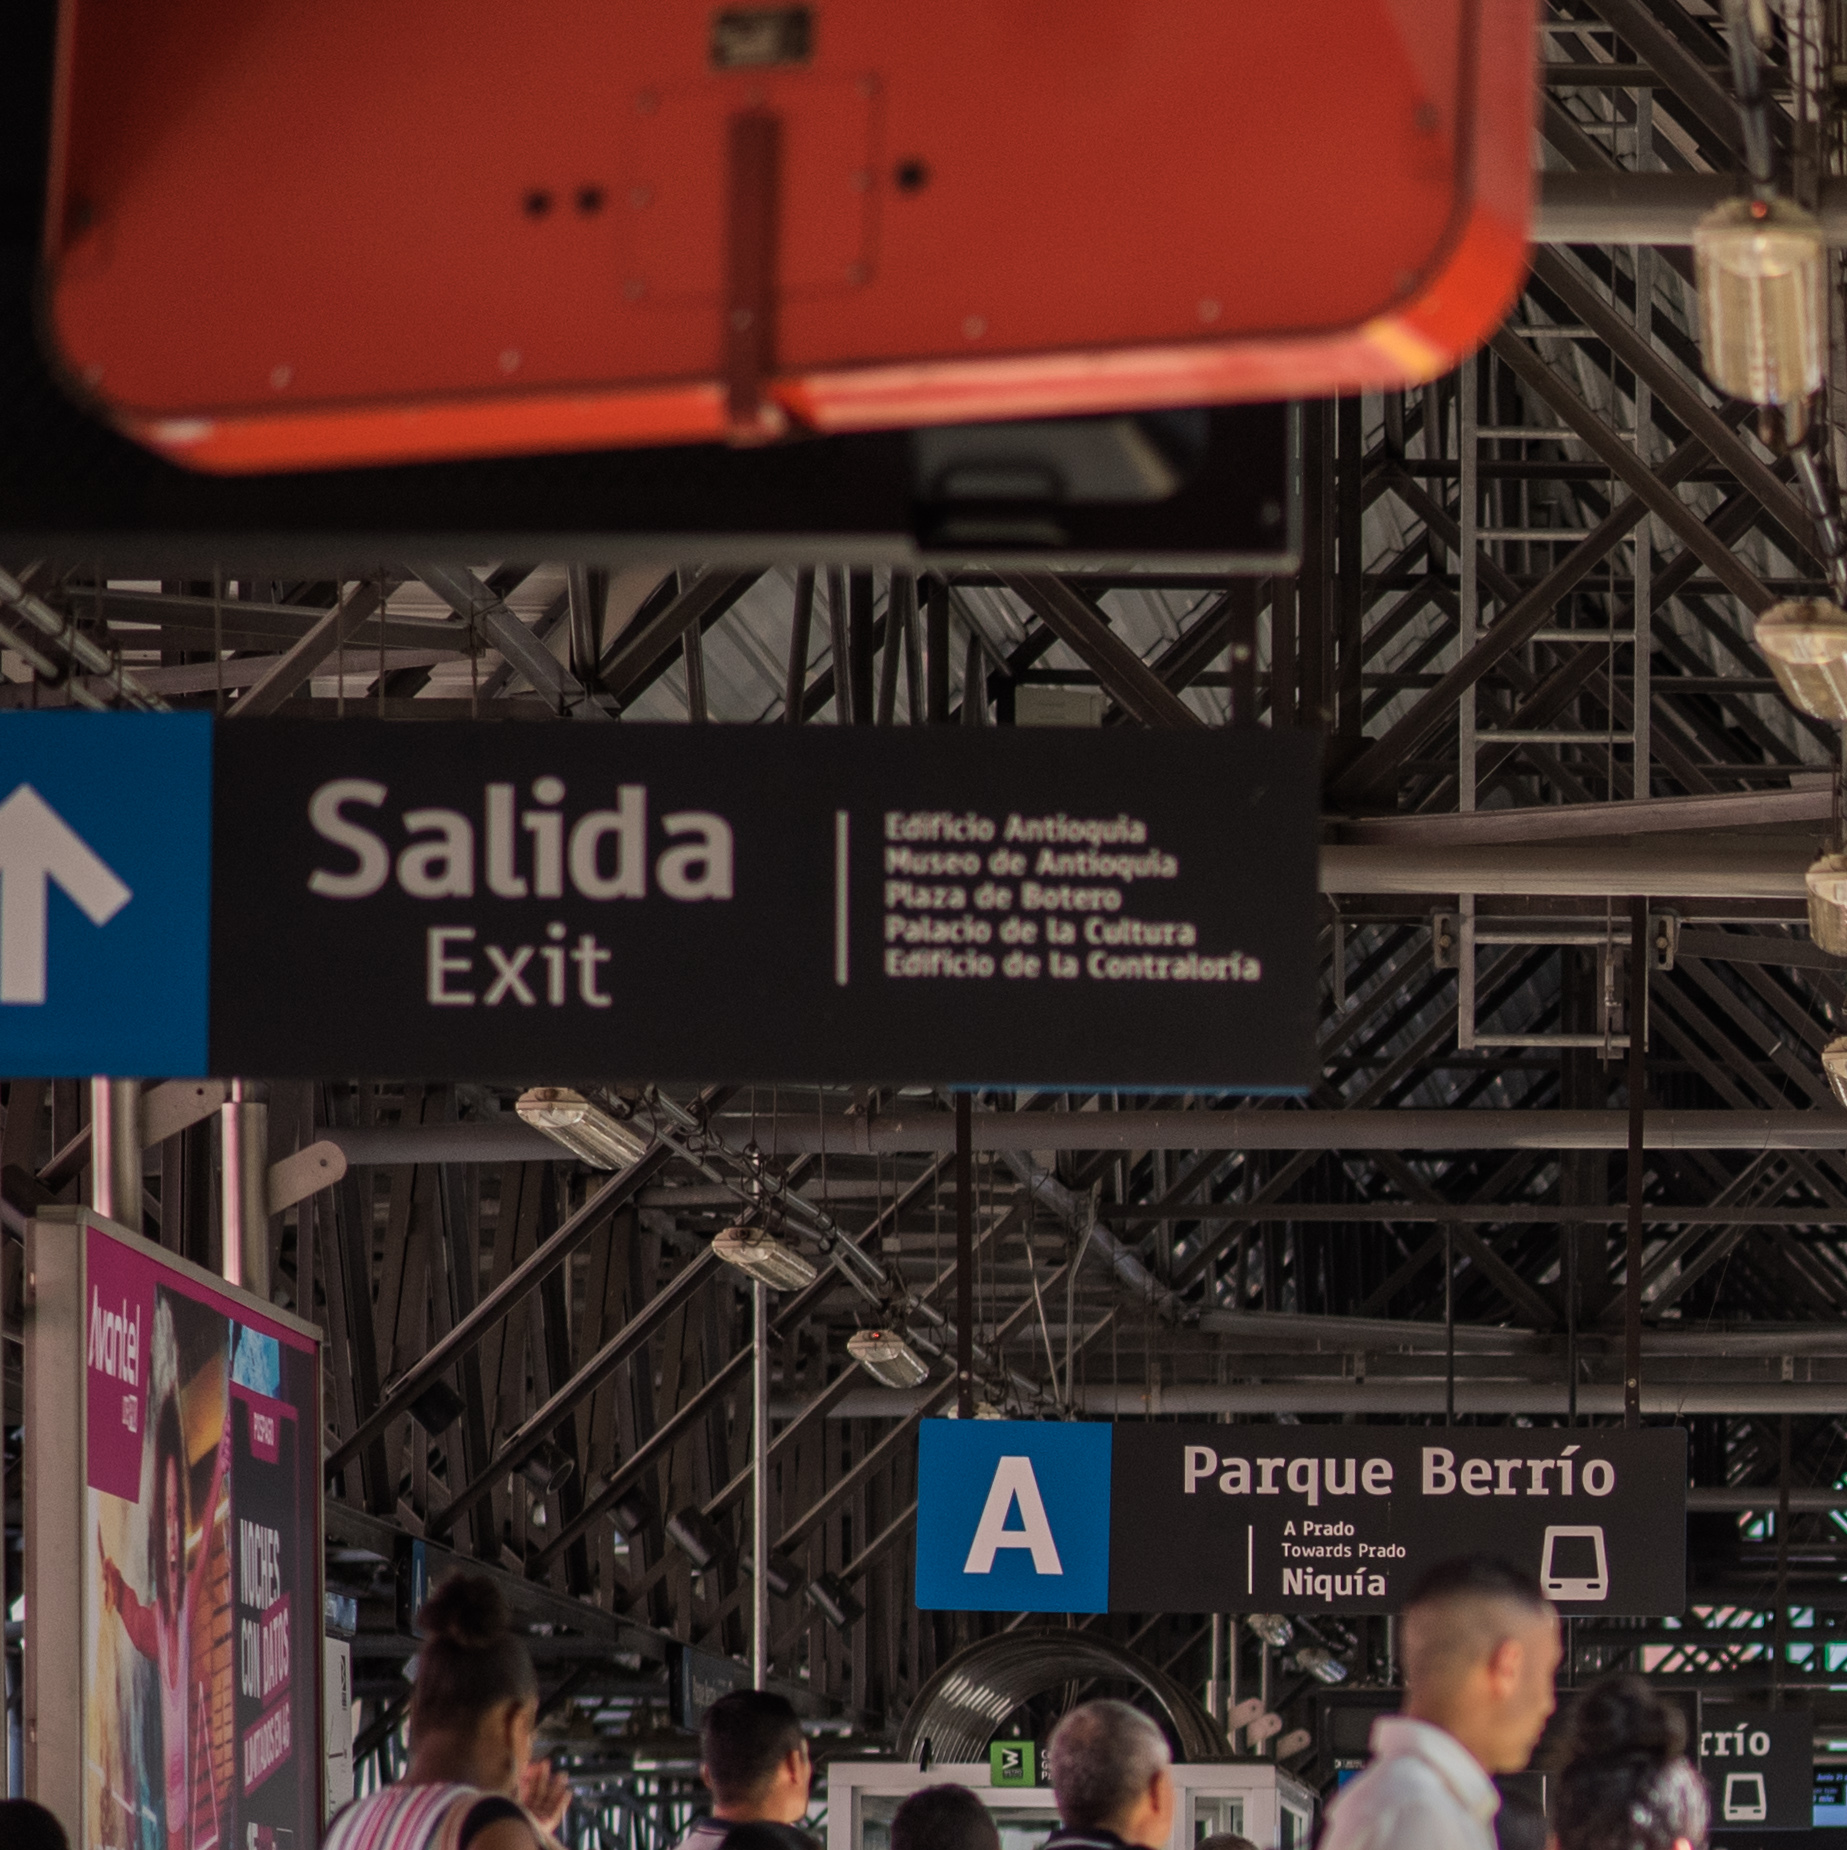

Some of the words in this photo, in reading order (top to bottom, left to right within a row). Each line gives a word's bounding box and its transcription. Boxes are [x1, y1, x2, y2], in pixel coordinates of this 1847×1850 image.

[307, 776, 734, 900] Salida
[884, 811, 996, 843] Edificio
[1002, 812, 1147, 847] Antioquia
[884, 846, 981, 876] Museo
[986, 848, 1027, 877] de
[1034, 847, 1179, 882] Antioquia
[884, 879, 968, 910] Plaza
[973, 881, 1013, 911] de
[1019, 880, 1123, 912] Botero
[884, 914, 992, 944] Palacio
[999, 915, 1038, 944] de
[1045, 915, 1077, 945] la
[1083, 916, 1197, 946] Cultura
[427, 922, 613, 1007] Exit
[884, 947, 996, 978] Edificio
[1002, 949, 1041, 979] de
[1048, 949, 1080, 979] la
[1086, 949, 1262, 981] Contraloría
[88, 1285, 140, 1387] Avantel
[962, 1455, 1064, 1576] A
[1183, 1445, 1393, 1506] Parque
[1421, 1445, 1616, 1497] Berrío
[1283, 1521, 1297, 1536] A
[1303, 1520, 1355, 1537] Prado
[240, 1518, 281, 1610] NOCHES
[1282, 1543, 1353, 1559] Towards
[1358, 1543, 1406, 1559] Prado
[1282, 1568, 1387, 1601] Niquía
[241, 1617, 261, 1699] CON
[263, 1607, 289, 1696] DATOS
[1701, 1723, 1771, 1756] rrío
